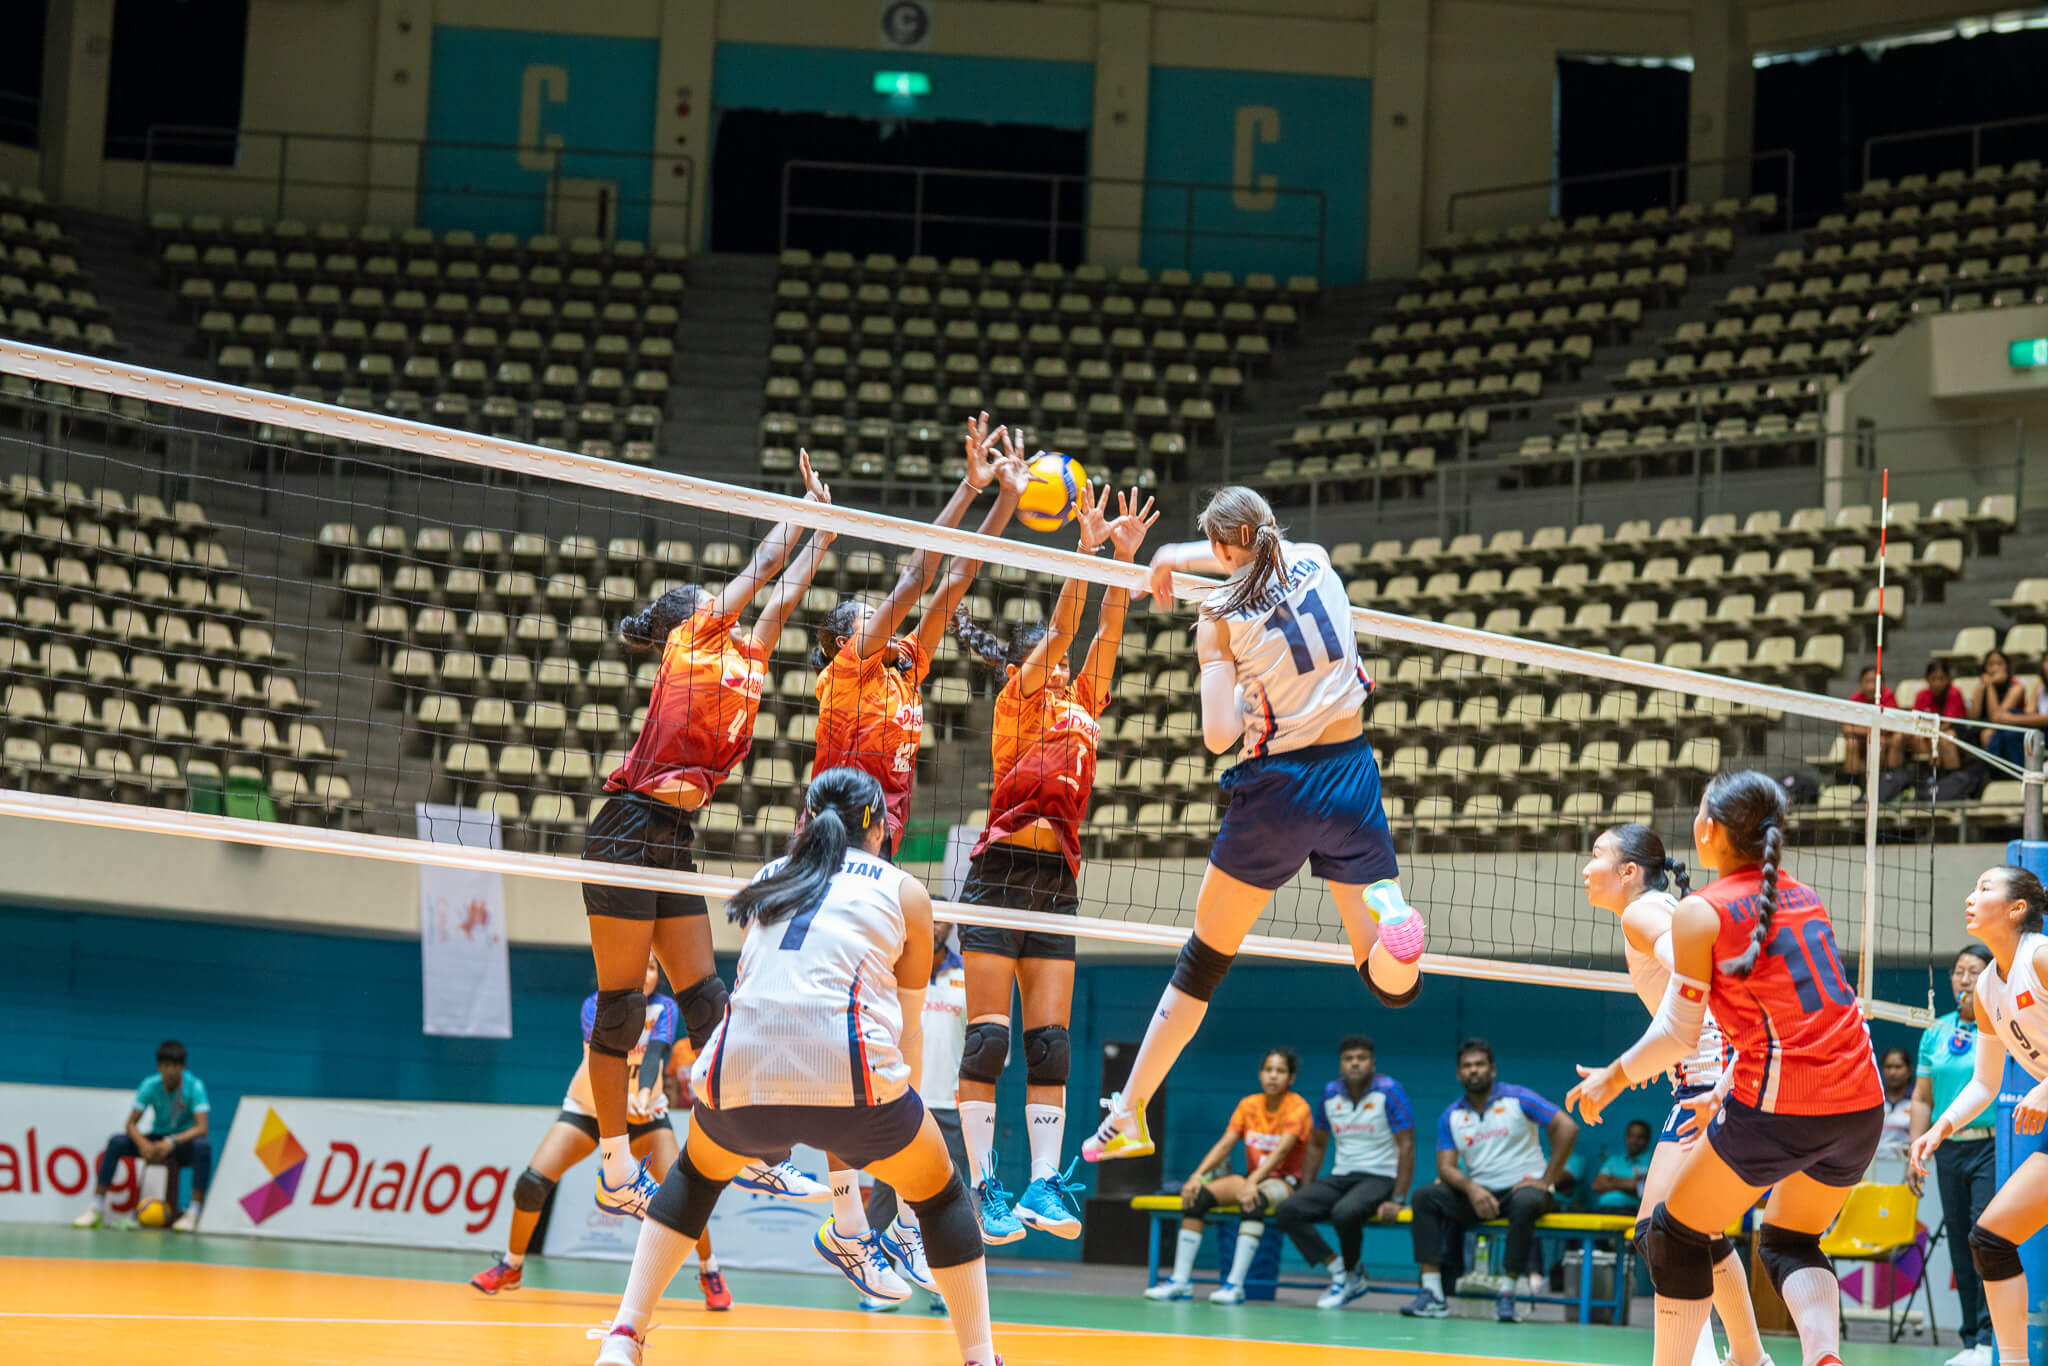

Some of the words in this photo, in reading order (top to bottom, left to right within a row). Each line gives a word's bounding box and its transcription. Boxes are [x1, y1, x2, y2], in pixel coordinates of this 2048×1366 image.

[518, 66, 567, 171] C
[1234, 106, 1279, 211] C
[1264, 588, 1345, 676] 11
[1764, 919, 1856, 1015] 10
[310, 1141, 511, 1234] Dialog
